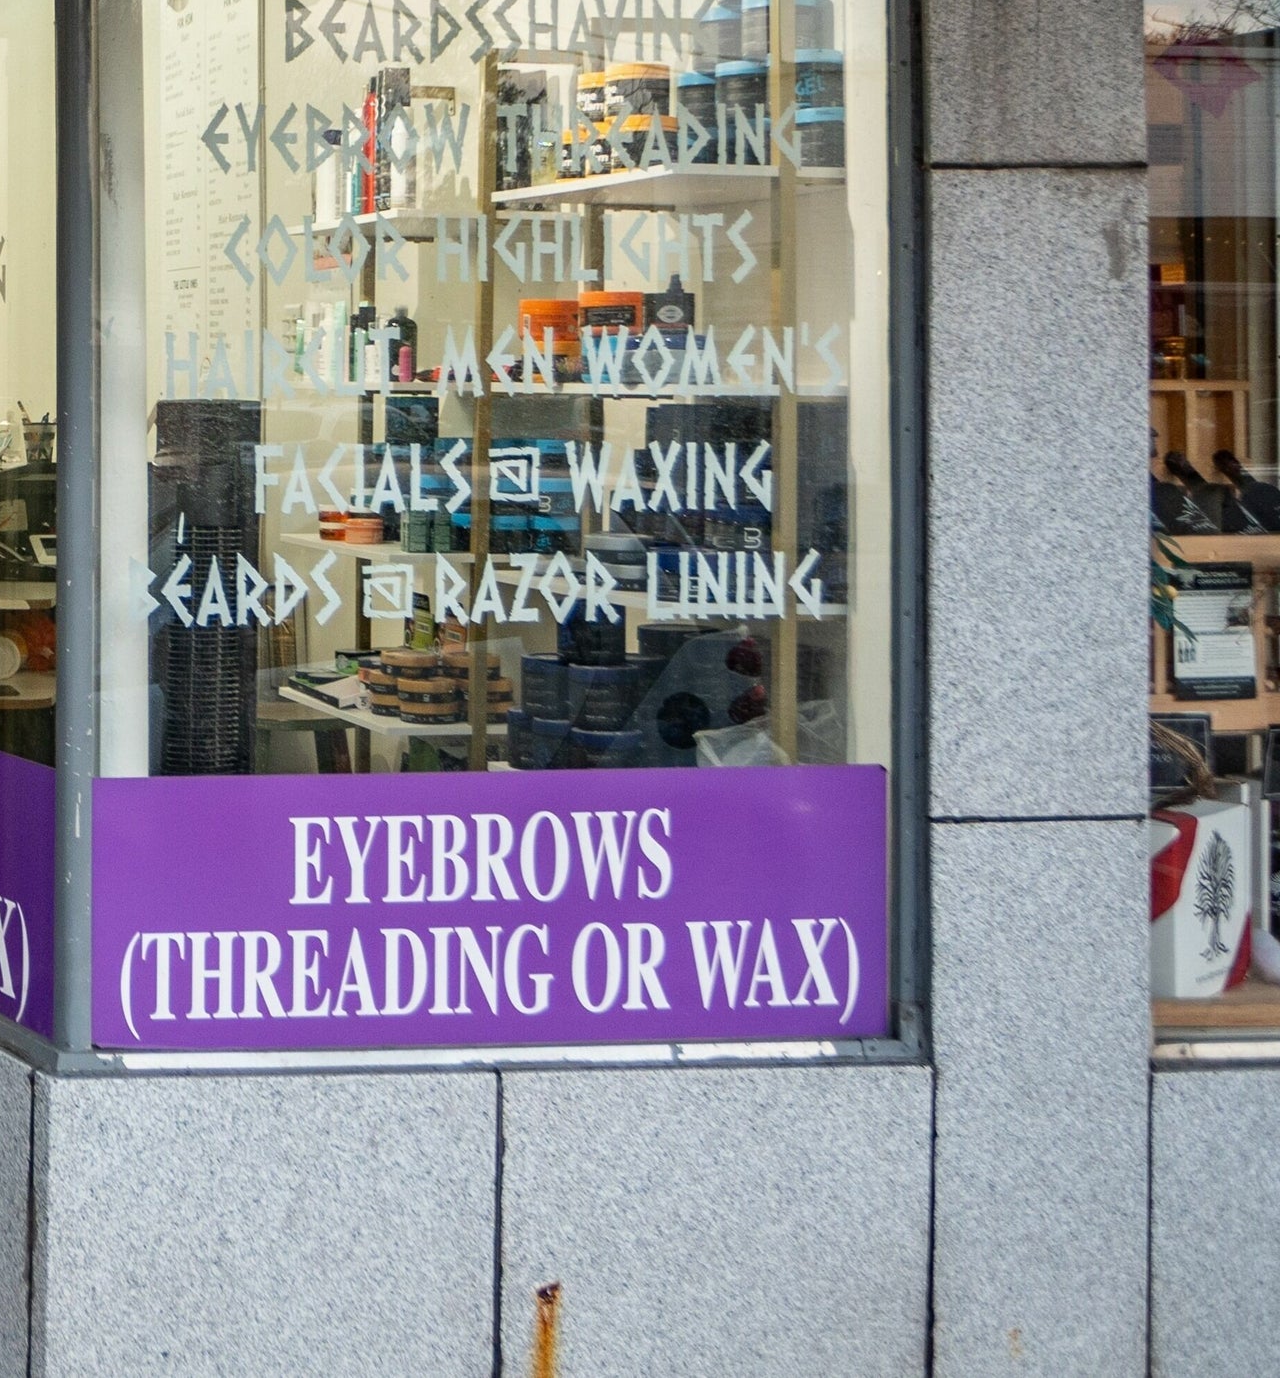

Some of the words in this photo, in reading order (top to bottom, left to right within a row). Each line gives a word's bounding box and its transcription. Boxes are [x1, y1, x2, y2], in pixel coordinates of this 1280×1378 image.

[201, 101, 471, 176] EYEBROW
[494, 101, 803, 174] THREADING
[223, 212, 411, 286] COLOR
[437, 209, 758, 286] HIGHLIGHTS
[164, 325, 401, 401] HAIRCUT
[441, 324, 555, 398] MEN
[581, 322, 842, 399] WOMEN'S
[254, 438, 472, 515] FACIALS
[564, 439, 773, 514] WAXING
[129, 549, 342, 627] BEARDS
[434, 550, 620, 626] RAZOR
[646, 547, 822, 621] LINING
[288, 807, 673, 906] EYEBROWS
[120, 919, 555, 1041] (THREADING
[571, 919, 671, 1013] OR
[684, 916, 860, 1025] WAX)
